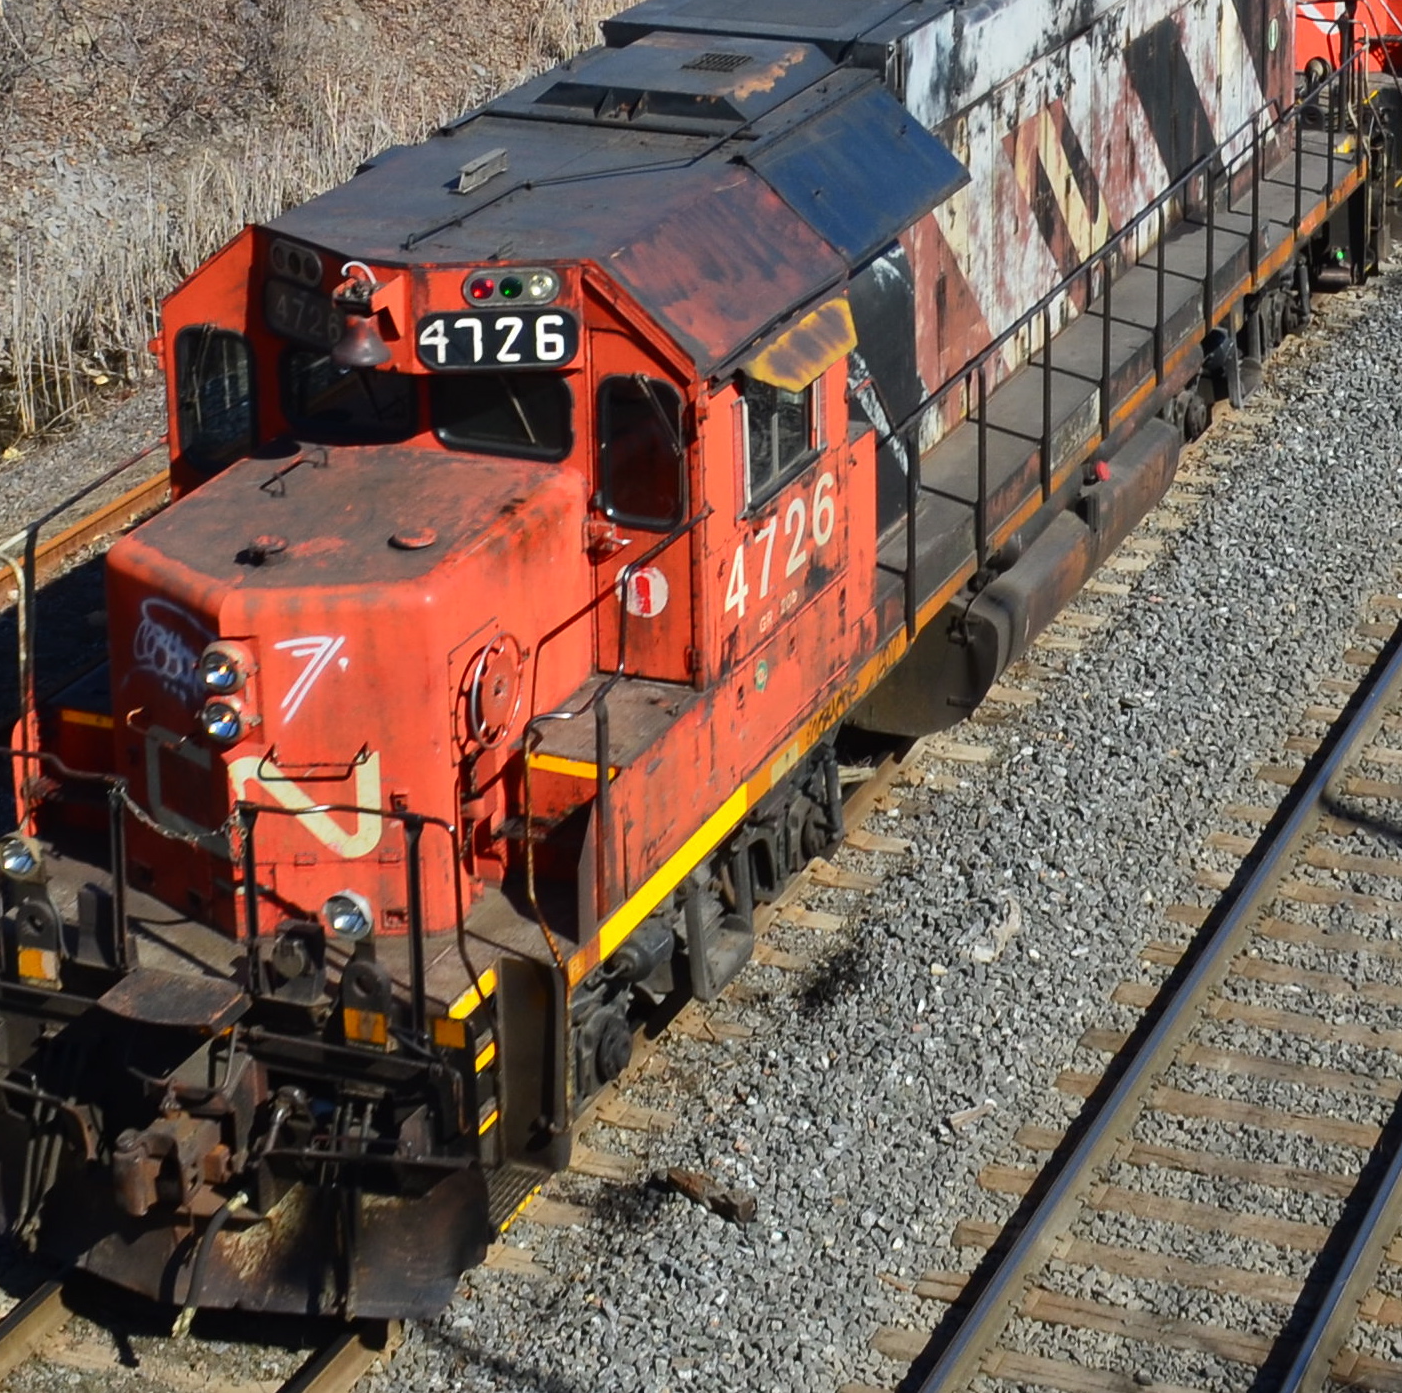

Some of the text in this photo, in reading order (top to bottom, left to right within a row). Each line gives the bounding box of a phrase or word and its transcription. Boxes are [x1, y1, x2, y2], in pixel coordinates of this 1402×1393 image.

[275, 293, 342, 345] 4726
[419, 314, 565, 364] 4726
[724, 471, 835, 620] 4726
